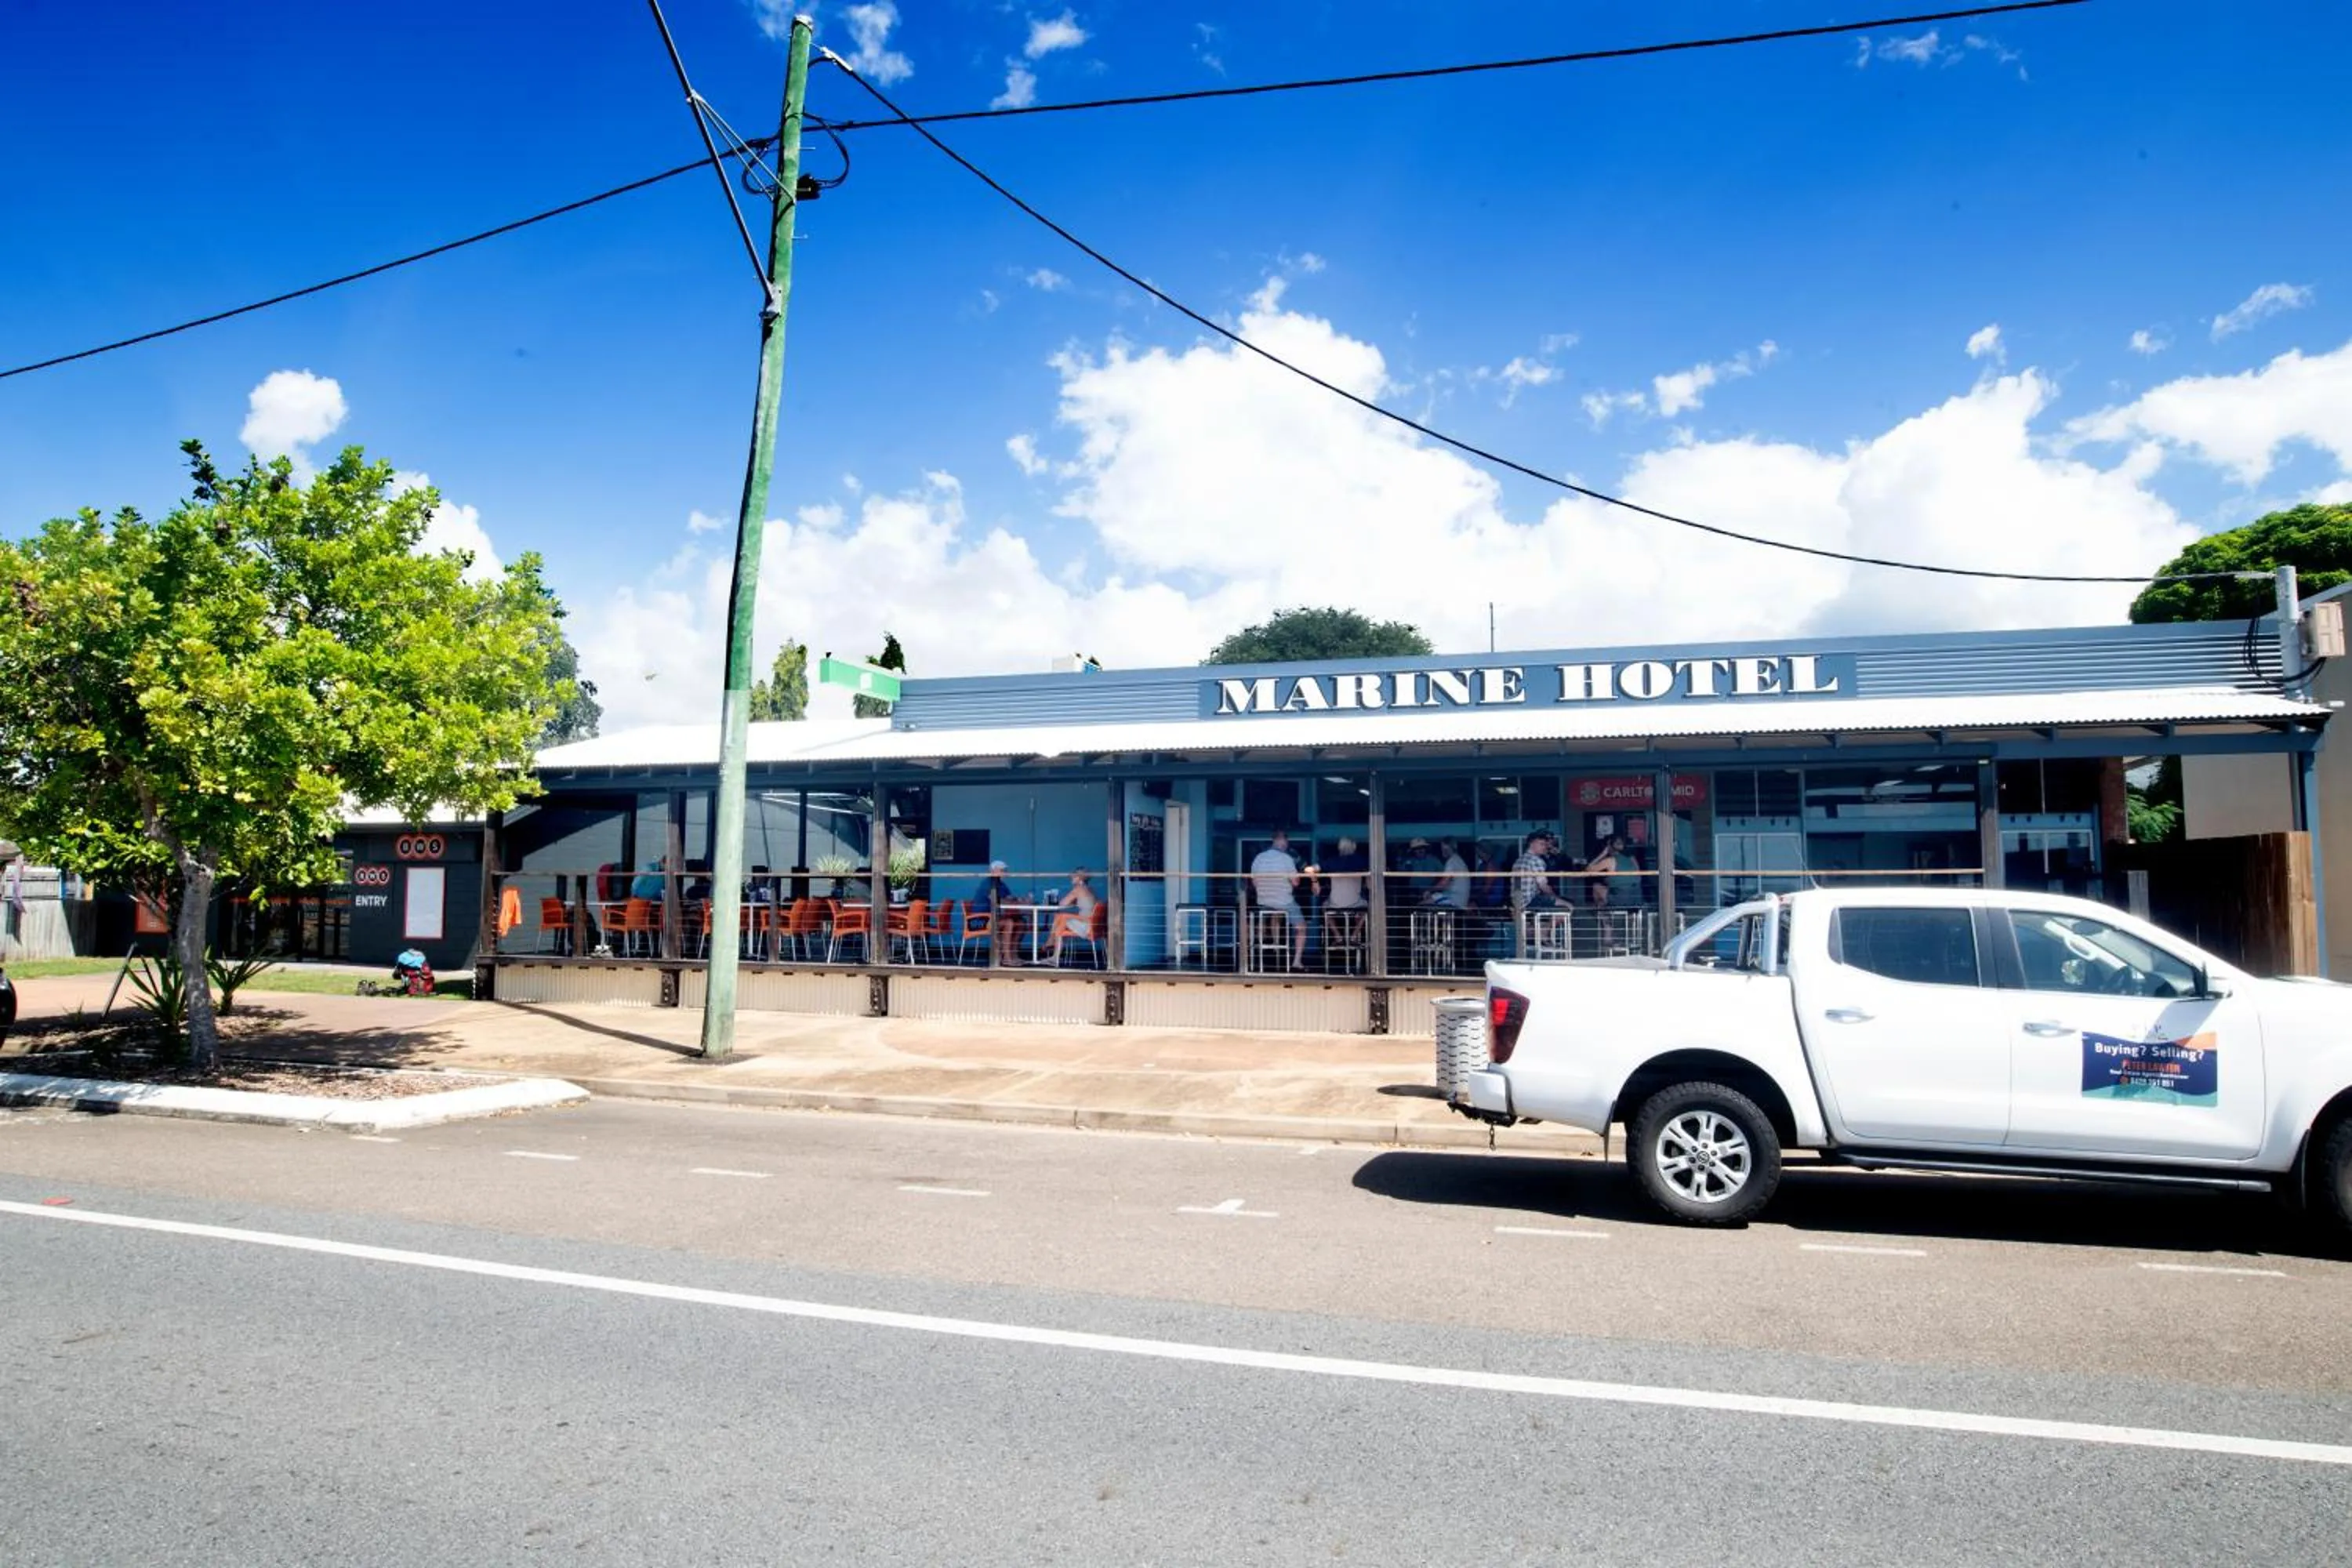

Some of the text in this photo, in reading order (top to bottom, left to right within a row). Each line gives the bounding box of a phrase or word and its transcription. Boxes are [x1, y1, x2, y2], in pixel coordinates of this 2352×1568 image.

[1215, 655, 1839, 715] MARINE HOTEL
[1602, 786, 1654, 798] CARLTO
[355, 895, 388, 907] ENTRY
[2094, 1041, 2205, 1062] Buying? Selling?
